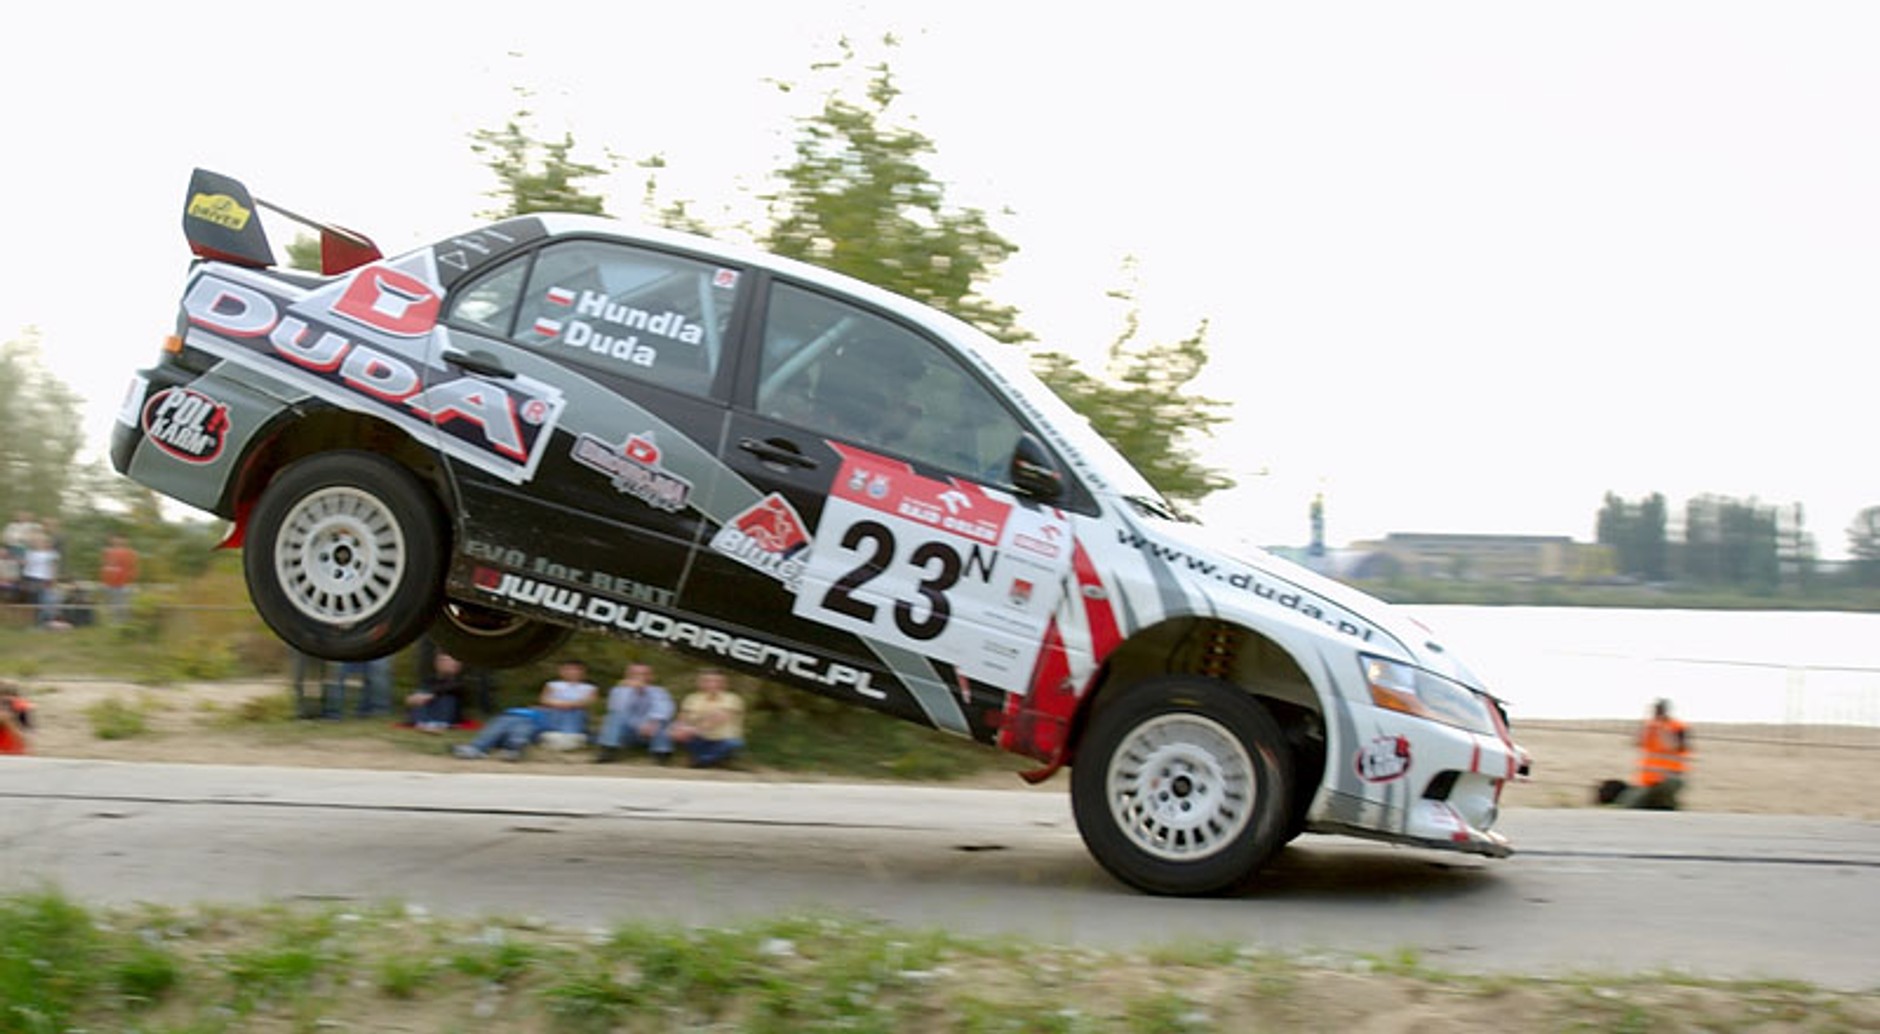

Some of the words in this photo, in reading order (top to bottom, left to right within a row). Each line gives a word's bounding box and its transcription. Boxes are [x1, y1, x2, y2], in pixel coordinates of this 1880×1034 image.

[564, 320, 657, 368] Duda
[576, 289, 705, 345] Hundla
[183, 274, 528, 463] DUDA
[534, 556, 586, 583] for
[590, 569, 678, 607] RENT
[819, 519, 963, 641] 23
[963, 543, 998, 584] N
[1117, 527, 1375, 643] www.duda.pl
